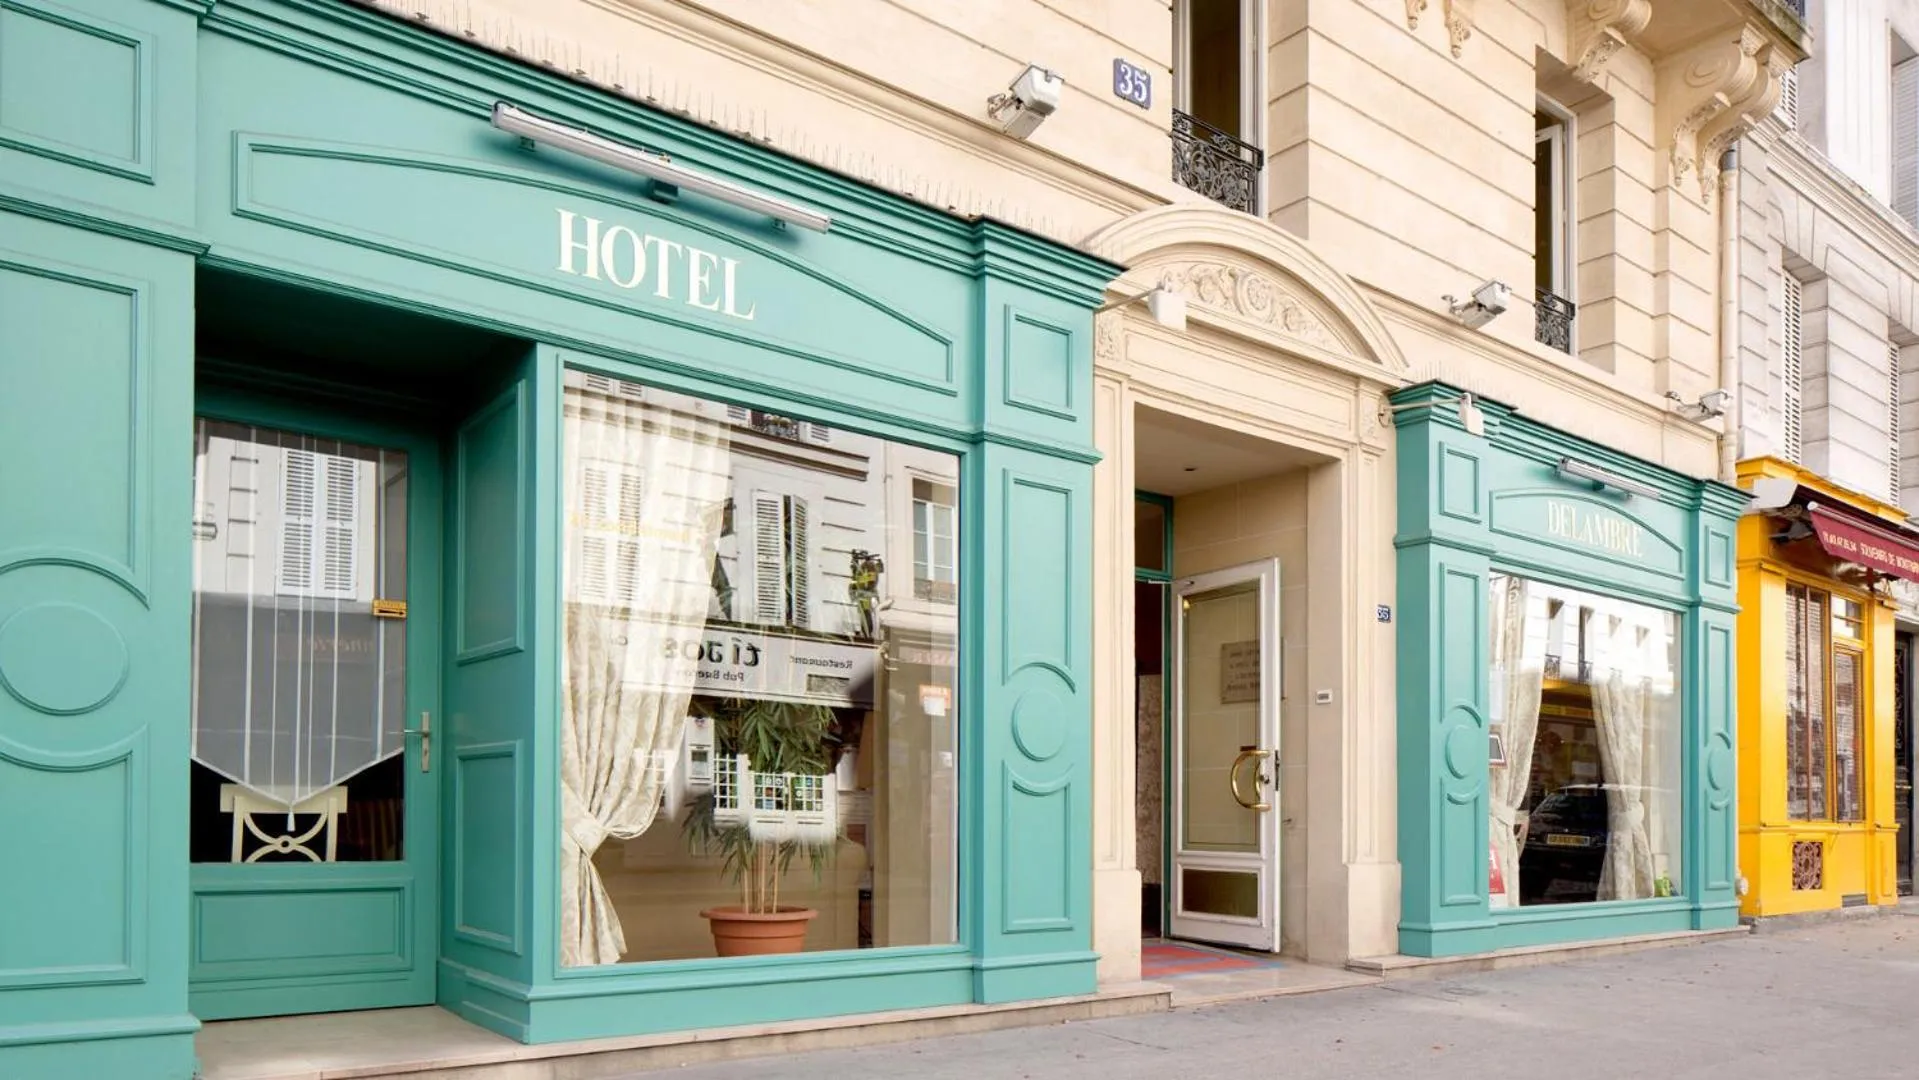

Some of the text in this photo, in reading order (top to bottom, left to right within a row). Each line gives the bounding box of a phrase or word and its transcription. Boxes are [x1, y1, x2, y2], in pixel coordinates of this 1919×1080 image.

[1120, 63, 1147, 102] 35
[555, 208, 756, 320] HOTEL
[1547, 499, 1643, 557] DELAMBRE
